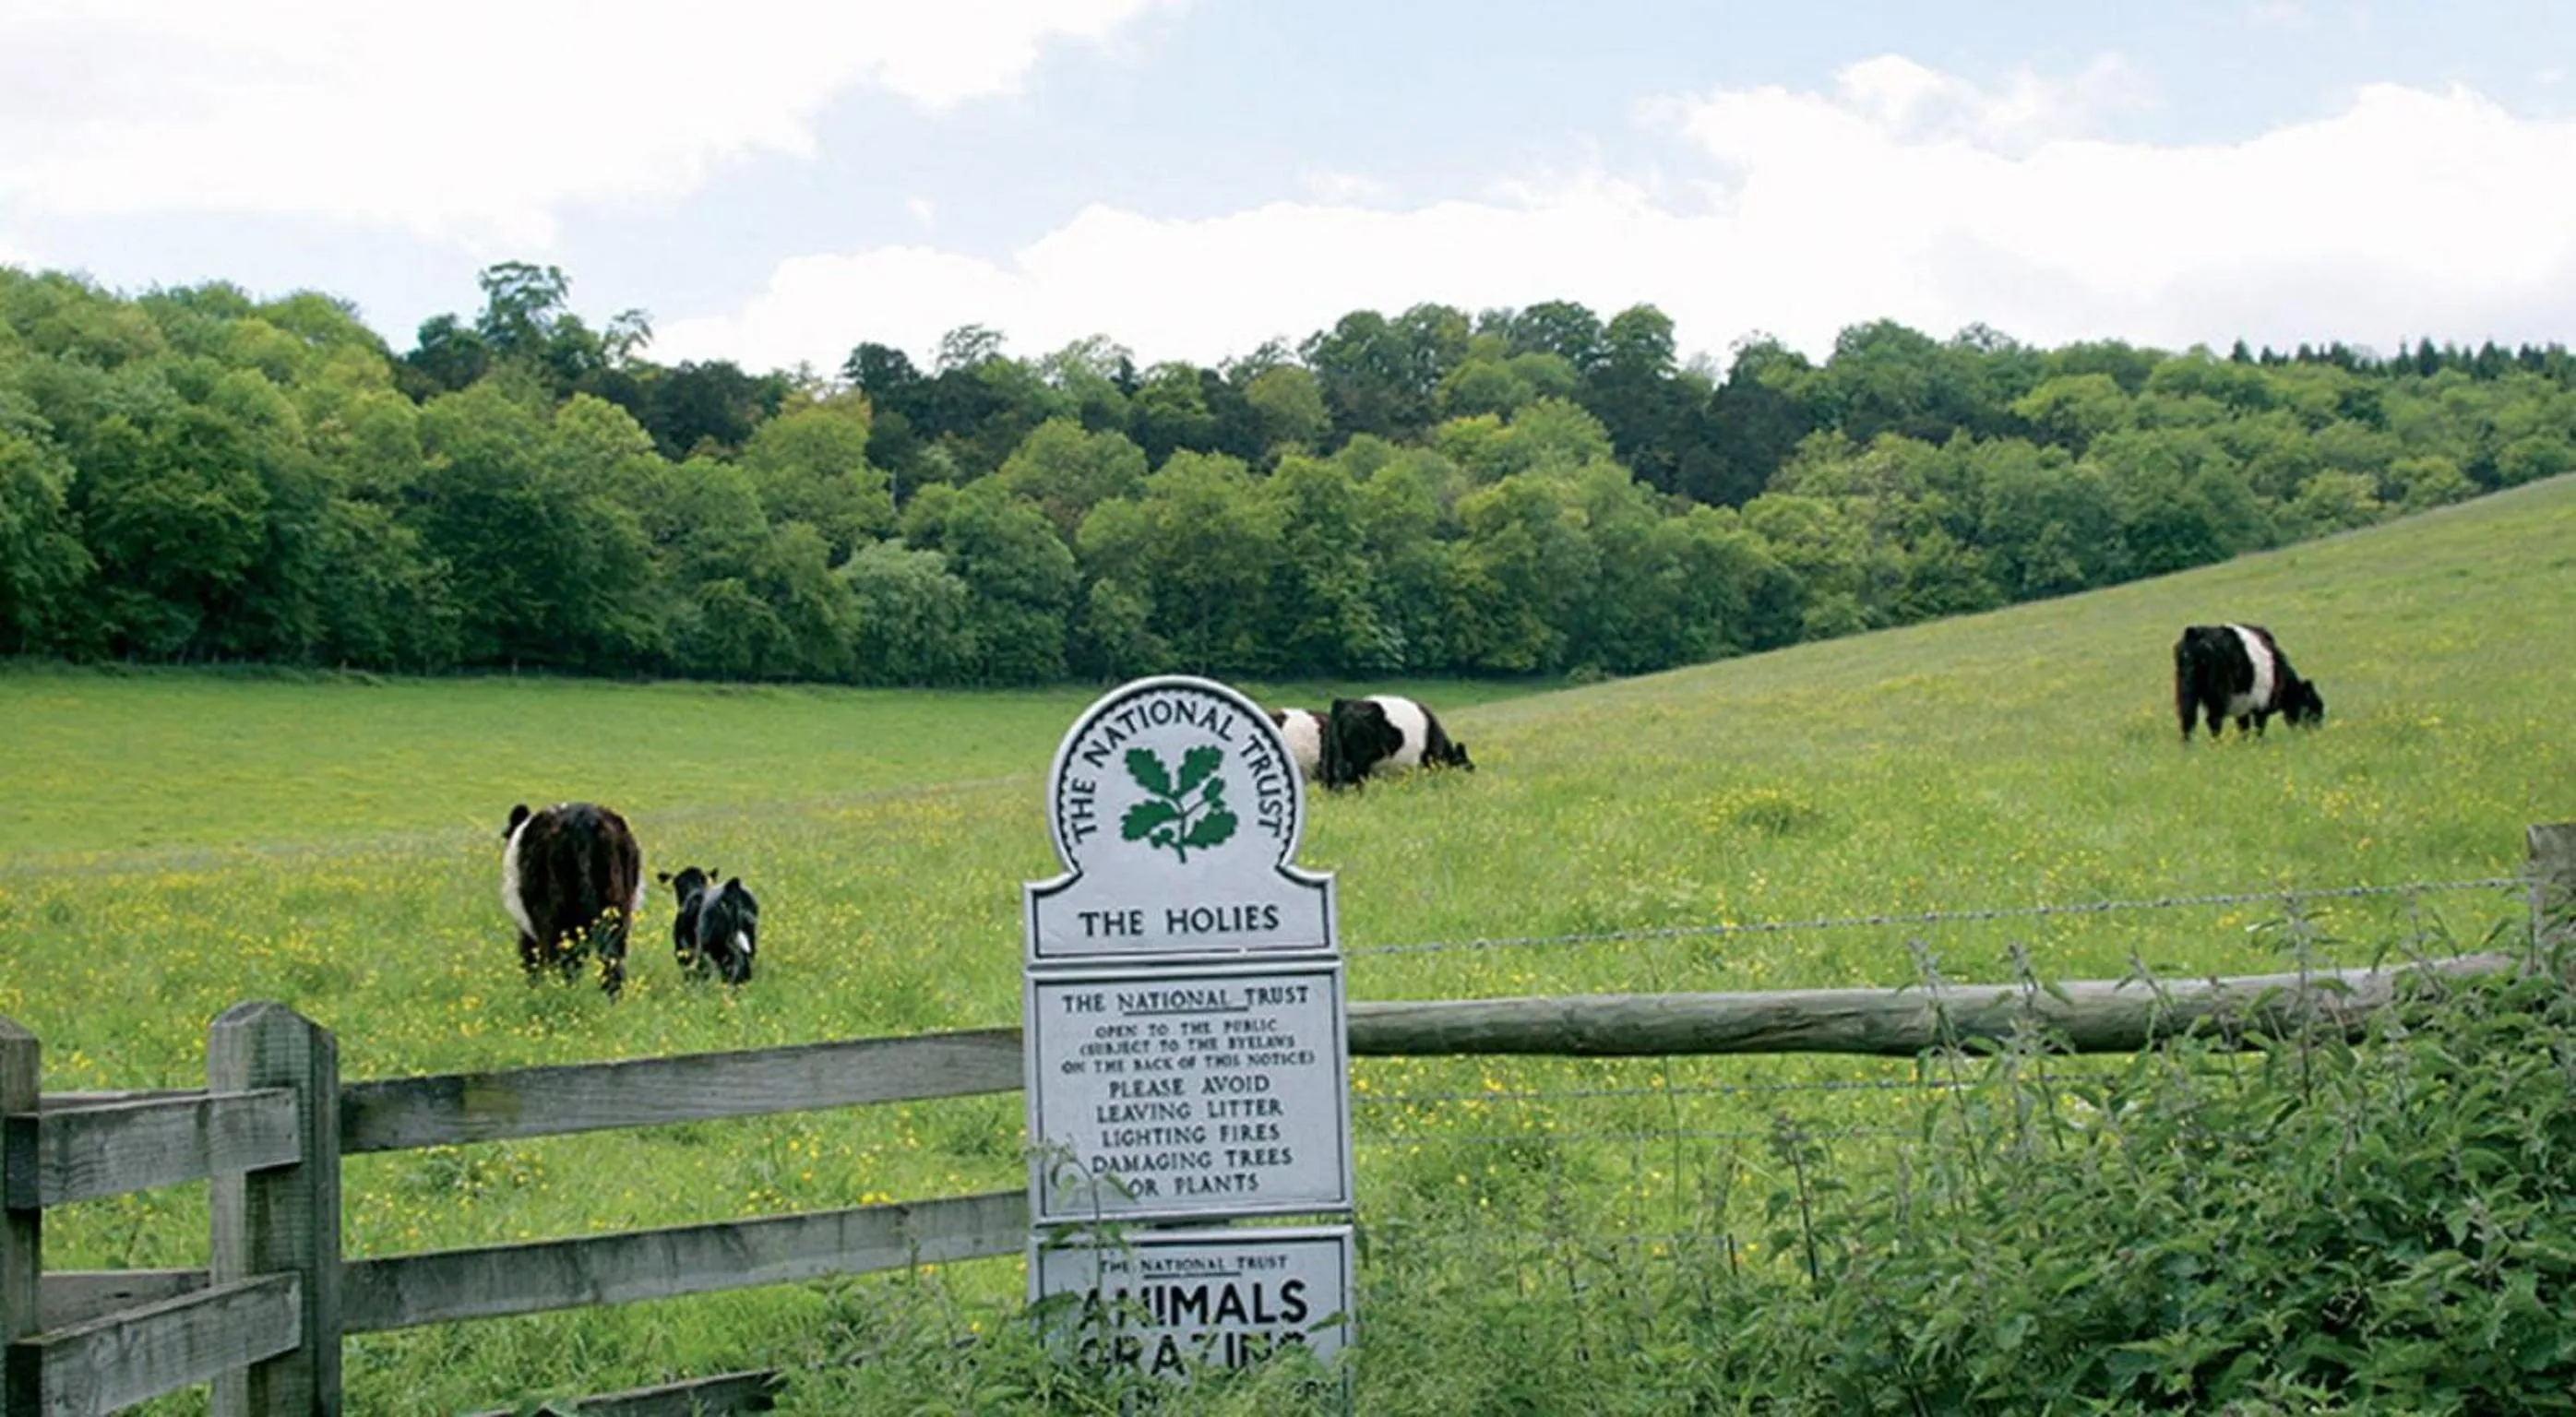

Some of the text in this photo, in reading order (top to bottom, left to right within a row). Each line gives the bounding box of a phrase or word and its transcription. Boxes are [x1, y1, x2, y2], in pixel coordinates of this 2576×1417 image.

[1070, 699, 1283, 844] THE NATIONAL TRUST
[1078, 904, 1280, 937] THE HOLIES
[1062, 985, 1309, 1013] THE NATIONAL TRUST
[1095, 1018, 1277, 1038] OPEN TO THE PUBLIC
[1160, 1039, 1179, 1053] TO
[1187, 1037, 1218, 1051] THE
[1062, 1061, 1085, 1074] ON
[1094, 1059, 1123, 1072] THE
[1134, 1058, 1173, 1071] BACK
[1177, 1055, 1196, 1068] OF
[1205, 1054, 1240, 1067] THIS
[1109, 1075, 1270, 1099] PLEASE AVOID
[1097, 1099, 1283, 1124] LEAVING LITTER
[1102, 1124, 1281, 1148] LIGHTING FIRES
[1092, 1148, 1293, 1174] DAMAGING TREES
[1128, 1173, 1259, 1197] OR PLANTS
[1140, 1256, 1224, 1271] NATIONAL
[1237, 1255, 1289, 1269] TRUST
